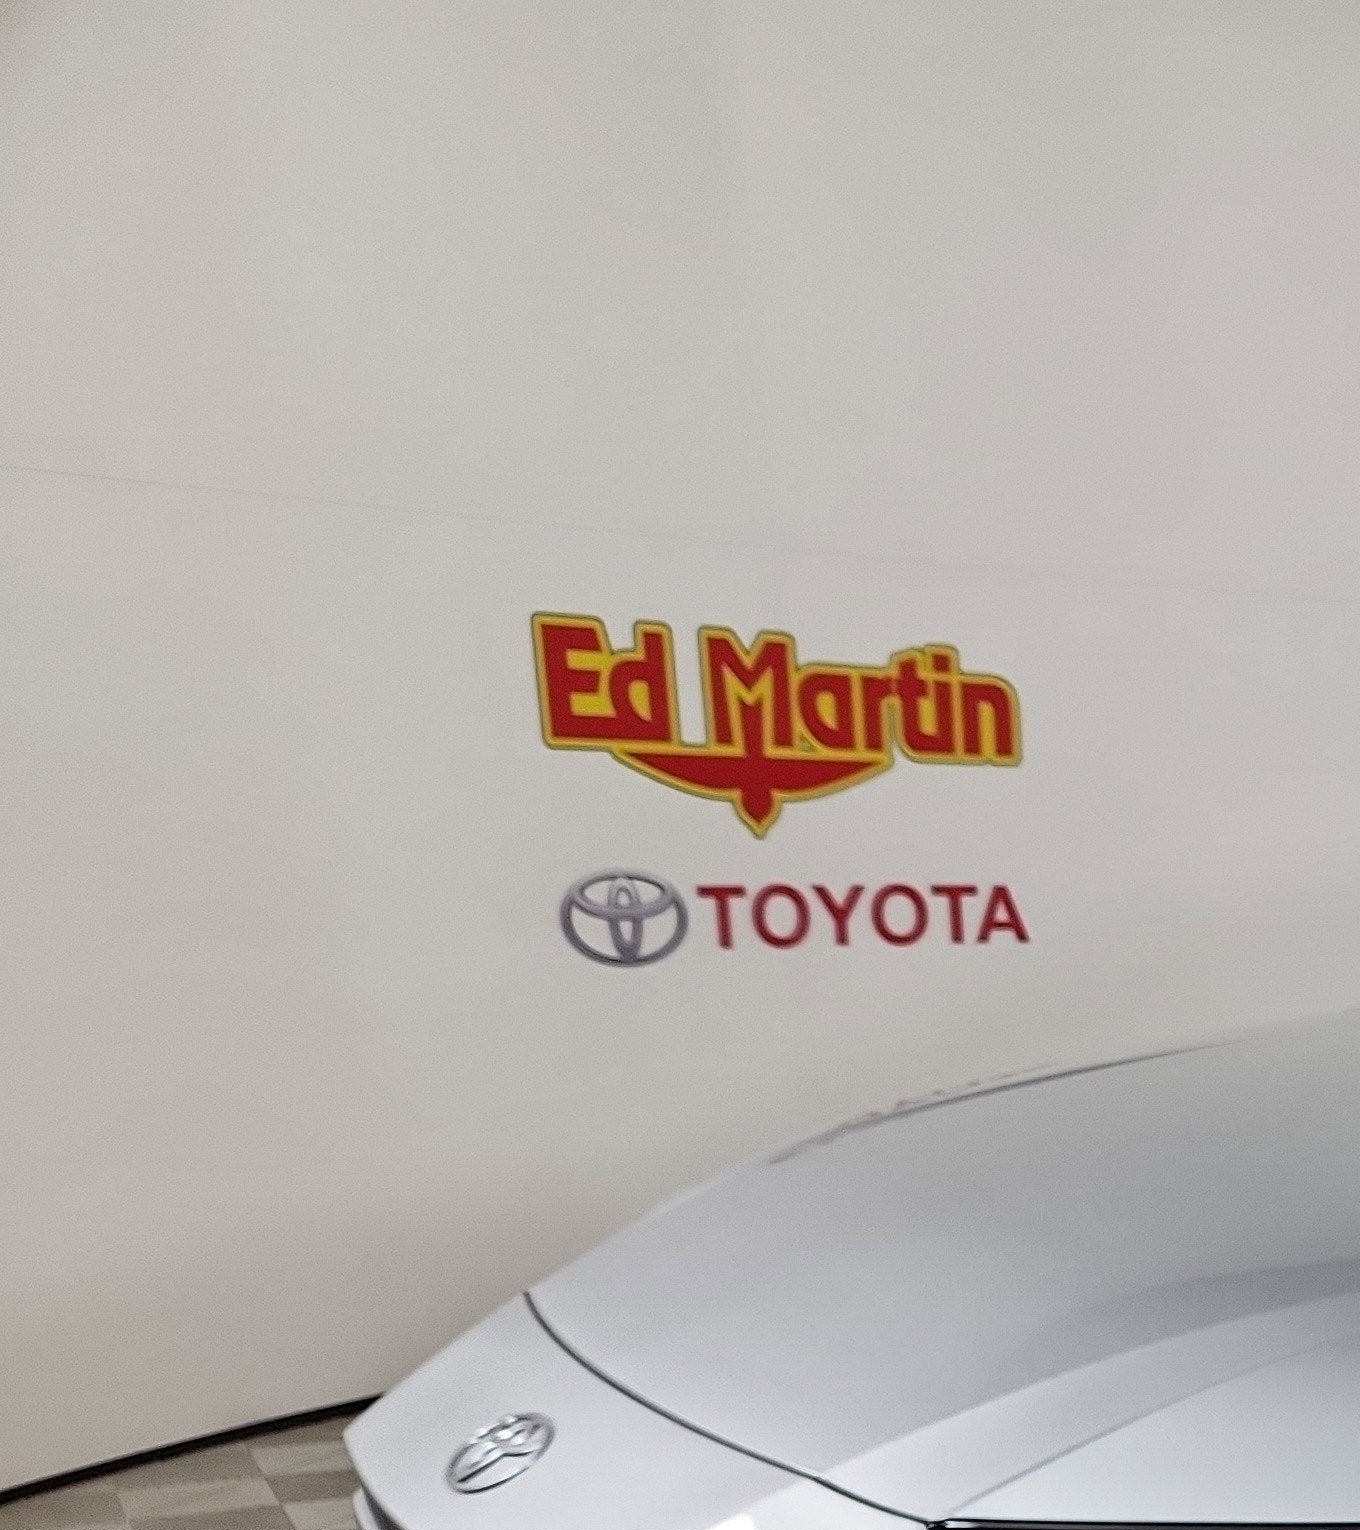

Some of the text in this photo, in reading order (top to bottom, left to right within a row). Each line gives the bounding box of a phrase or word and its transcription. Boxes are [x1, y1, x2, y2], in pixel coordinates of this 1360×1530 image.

[535, 616, 1020, 764] Ed Martin
[696, 883, 1030, 949] TOYOTA
